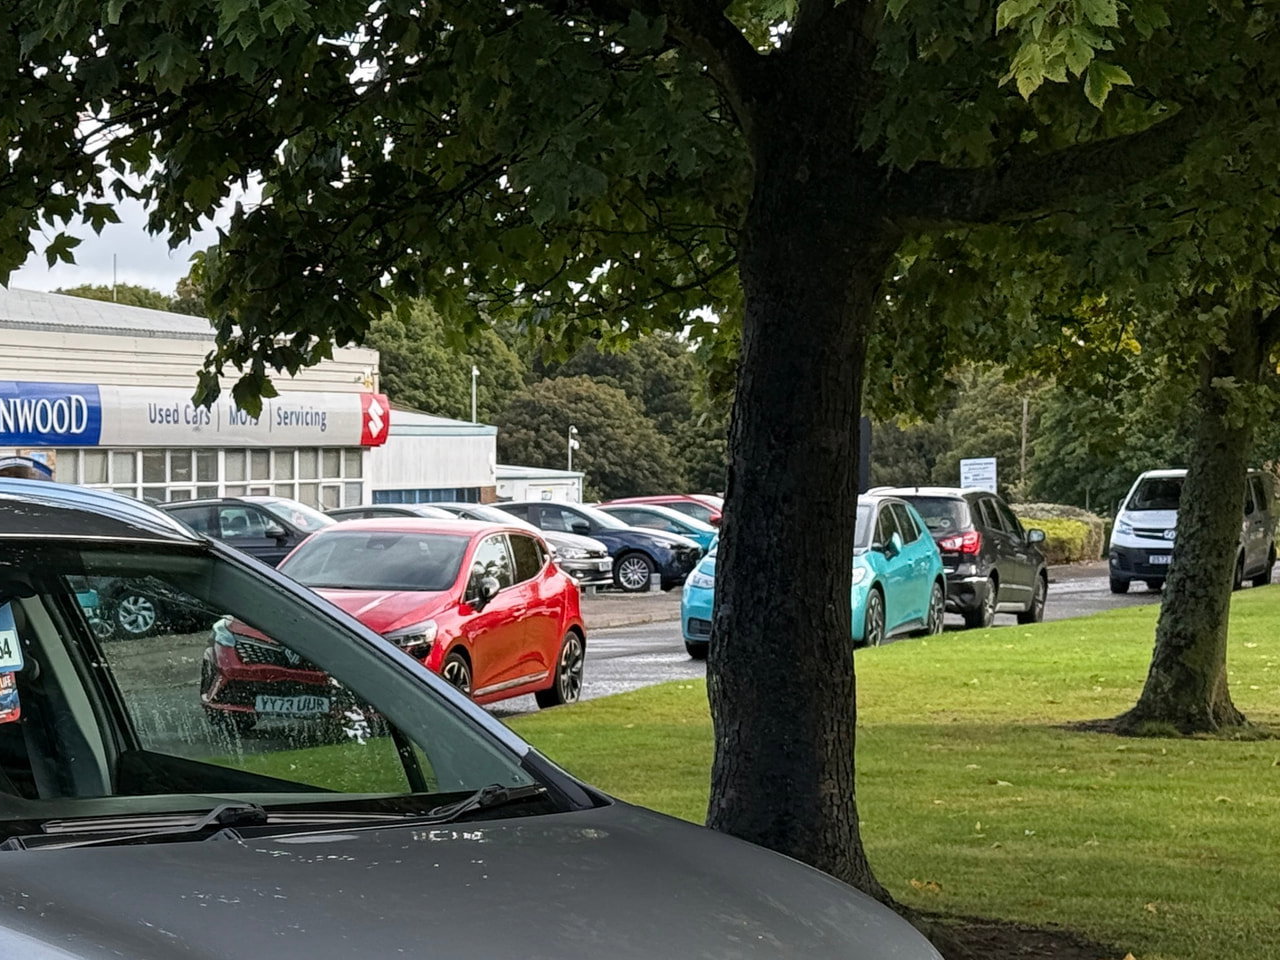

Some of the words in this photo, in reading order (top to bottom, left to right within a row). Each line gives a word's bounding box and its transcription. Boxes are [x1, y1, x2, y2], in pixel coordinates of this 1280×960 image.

[148, 402, 179, 424] Used
[184, 403, 211, 425] Cars
[276, 406, 327, 432] Servicing
